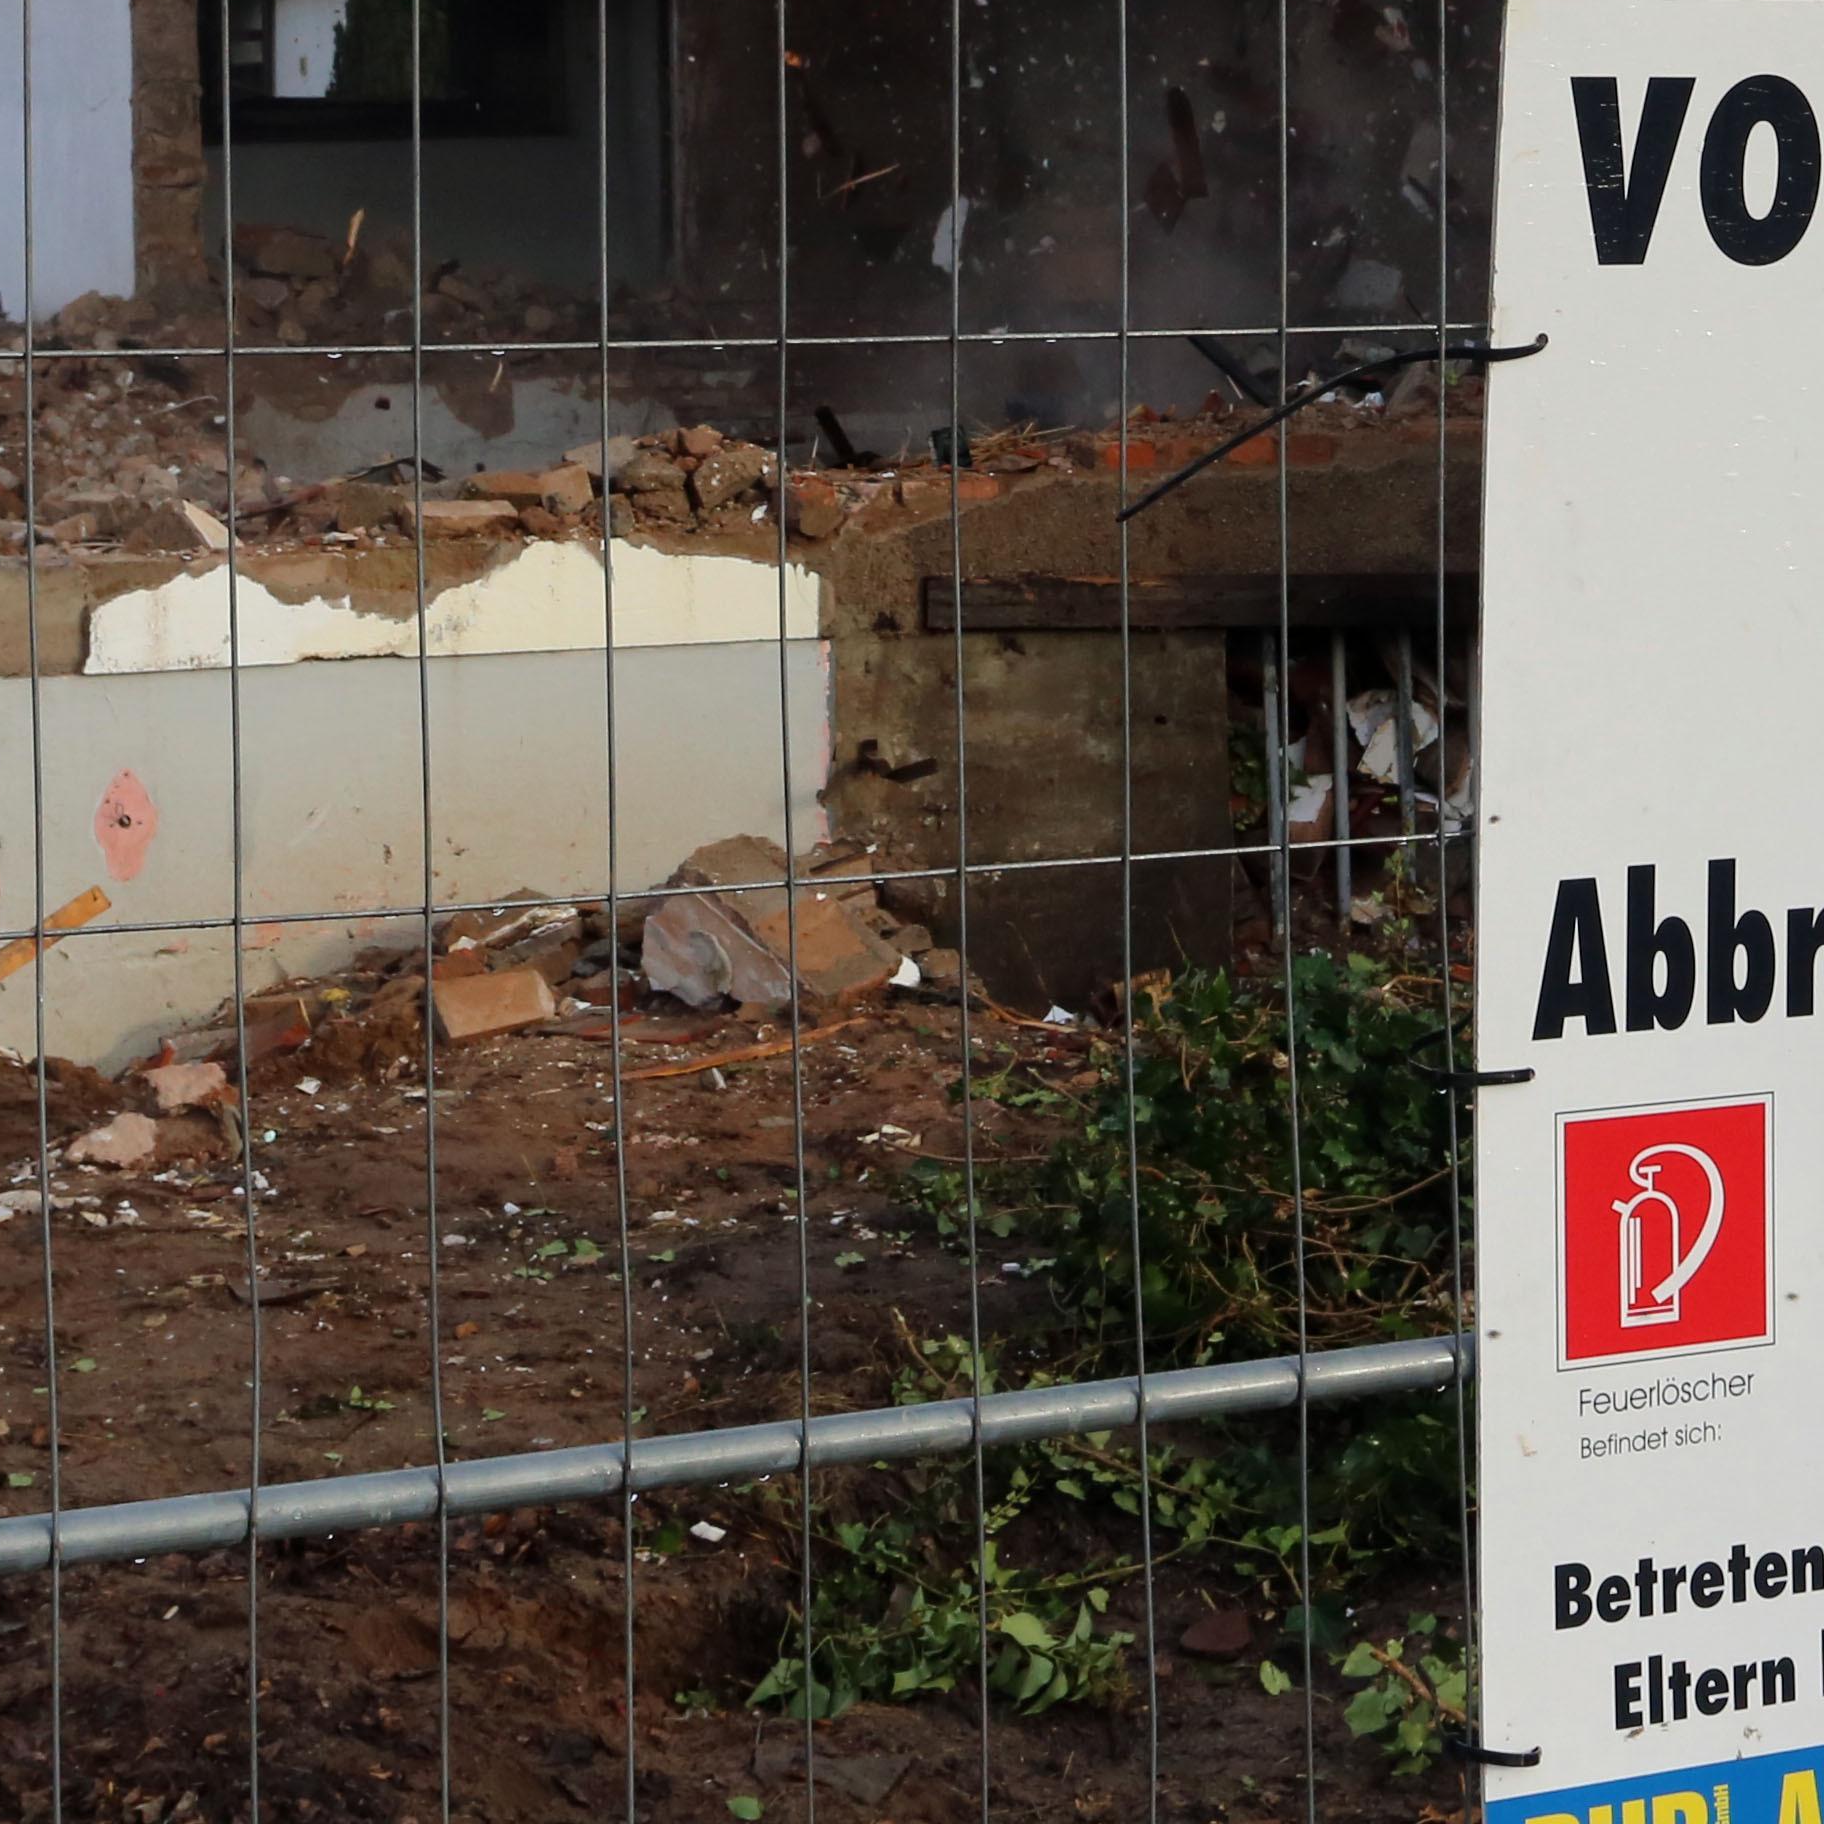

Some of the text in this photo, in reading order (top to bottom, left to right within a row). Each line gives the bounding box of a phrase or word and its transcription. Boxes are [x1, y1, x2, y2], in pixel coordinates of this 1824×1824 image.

[1579, 1372, 1755, 1417] Feuerlöscher
[1581, 1421, 1722, 1460] Befindet sich:
[1555, 1545, 1824, 1630] Betreten
[1614, 1655, 1796, 1730] Eltern
